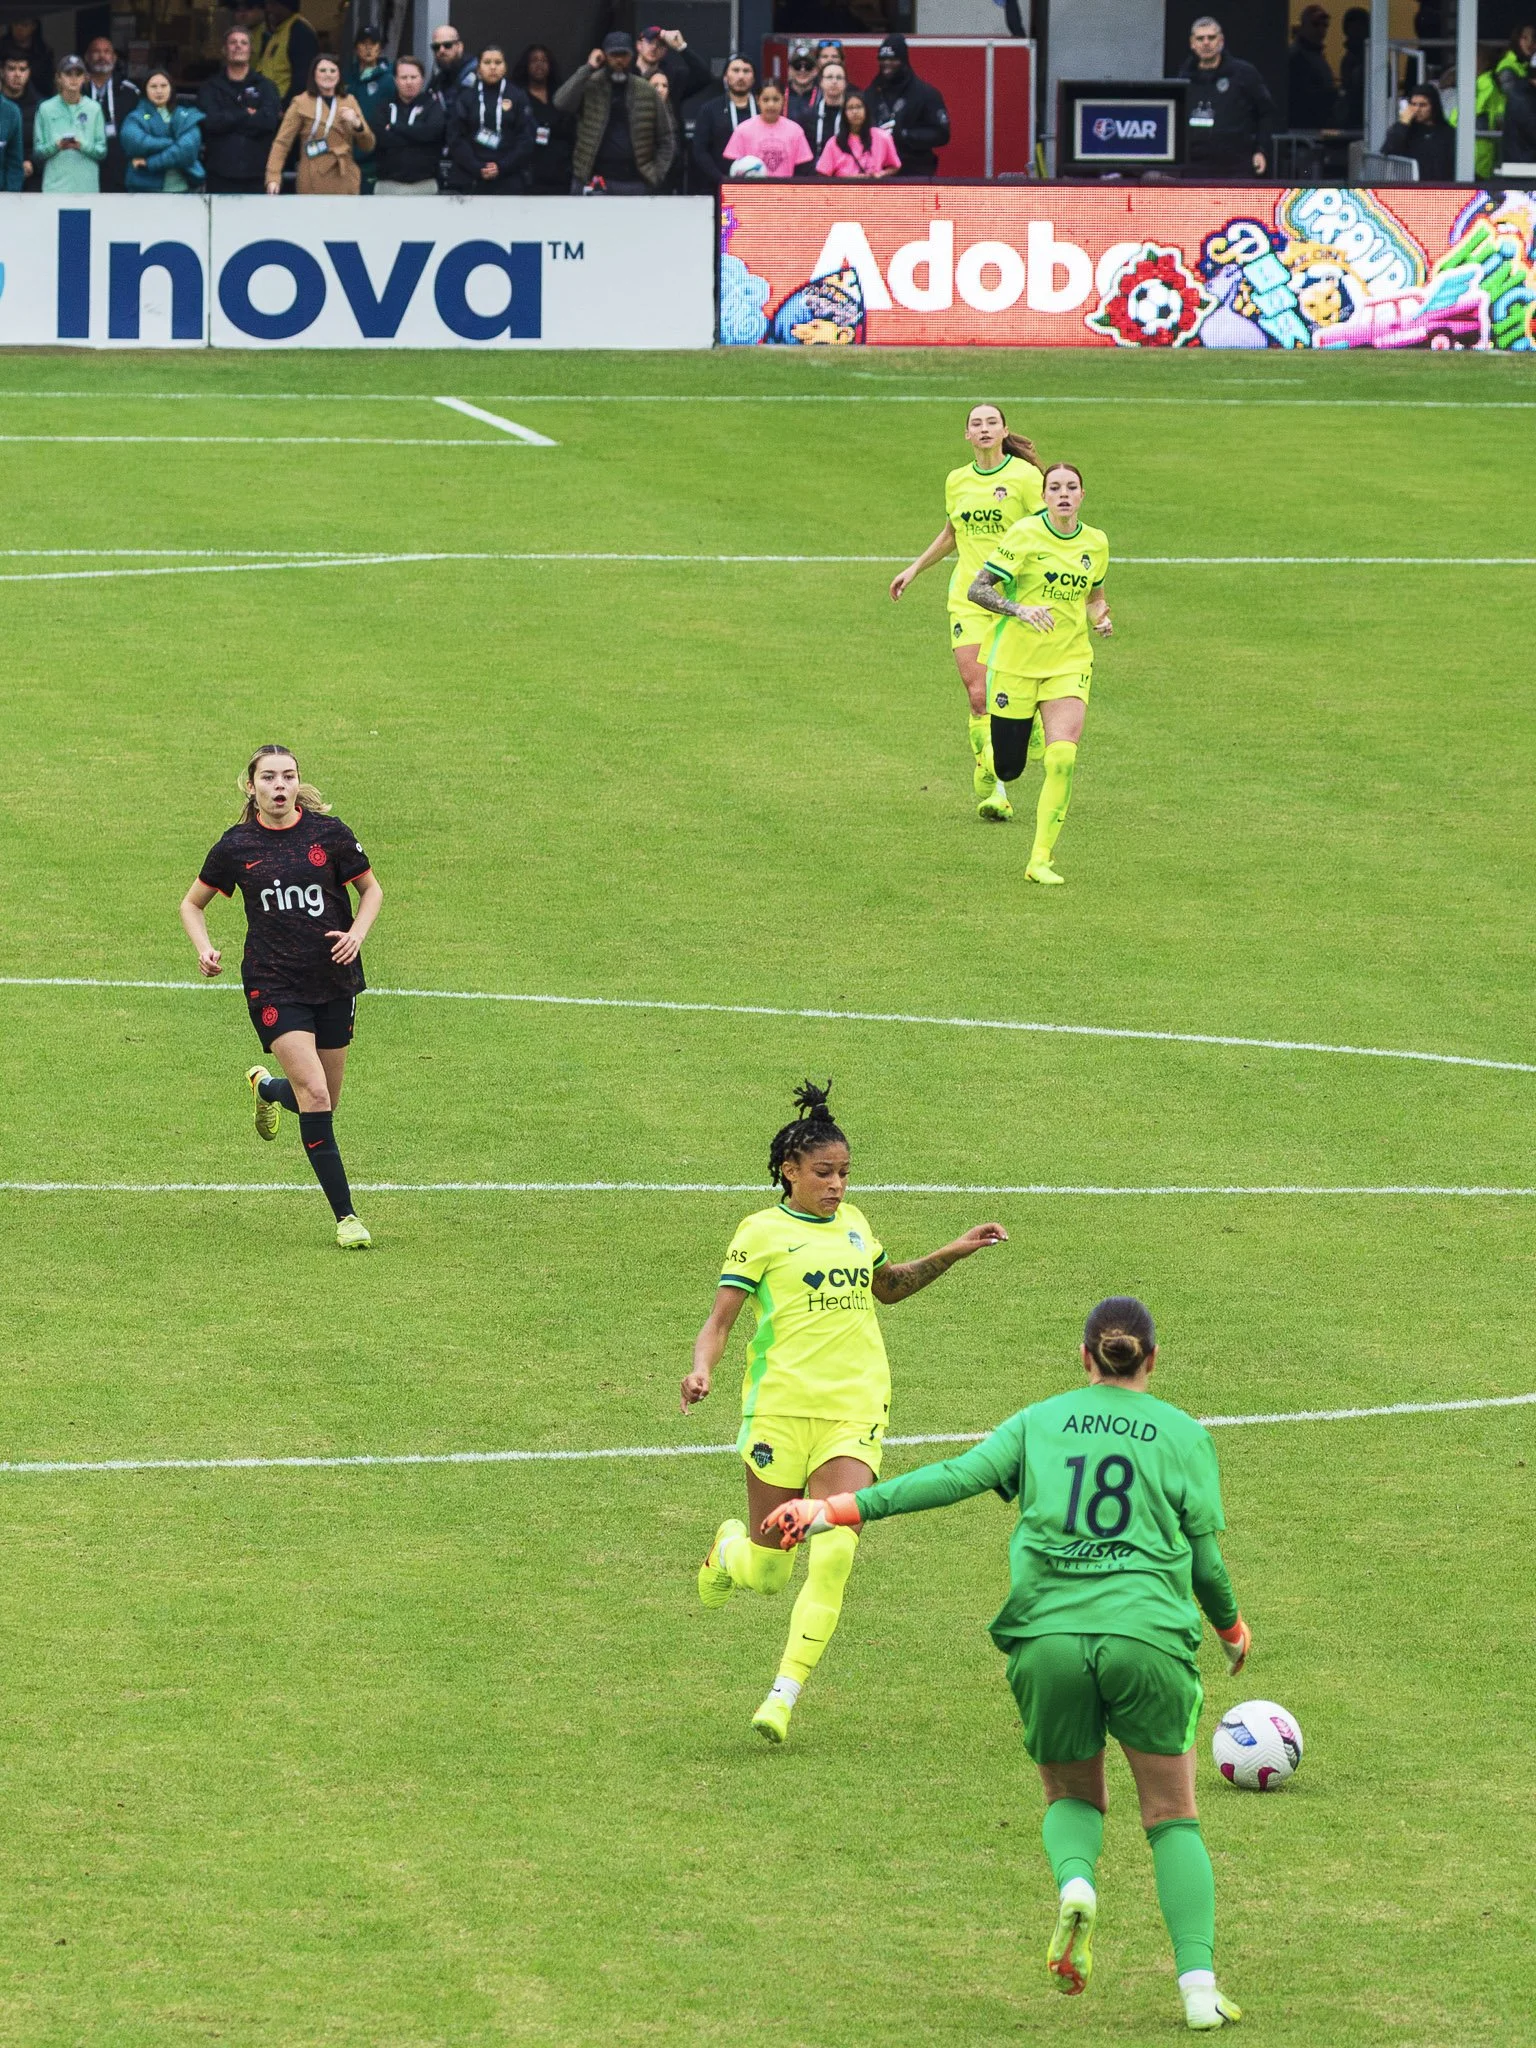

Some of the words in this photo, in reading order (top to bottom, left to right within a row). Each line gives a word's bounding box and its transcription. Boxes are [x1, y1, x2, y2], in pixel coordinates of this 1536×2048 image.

[1115, 120, 1157, 138] VAR
[1299, 188, 1407, 295] PROUD
[57, 209, 543, 340] Inova
[973, 509, 1003, 522] CVS
[1060, 573, 1088, 588] CVS
[260, 879, 325, 917] ring
[829, 1268, 870, 1288] CVS
[807, 1290, 869, 1312] Health
[1063, 1414, 1157, 1442] ARNOLD
[1063, 1452, 1135, 1538] 18
